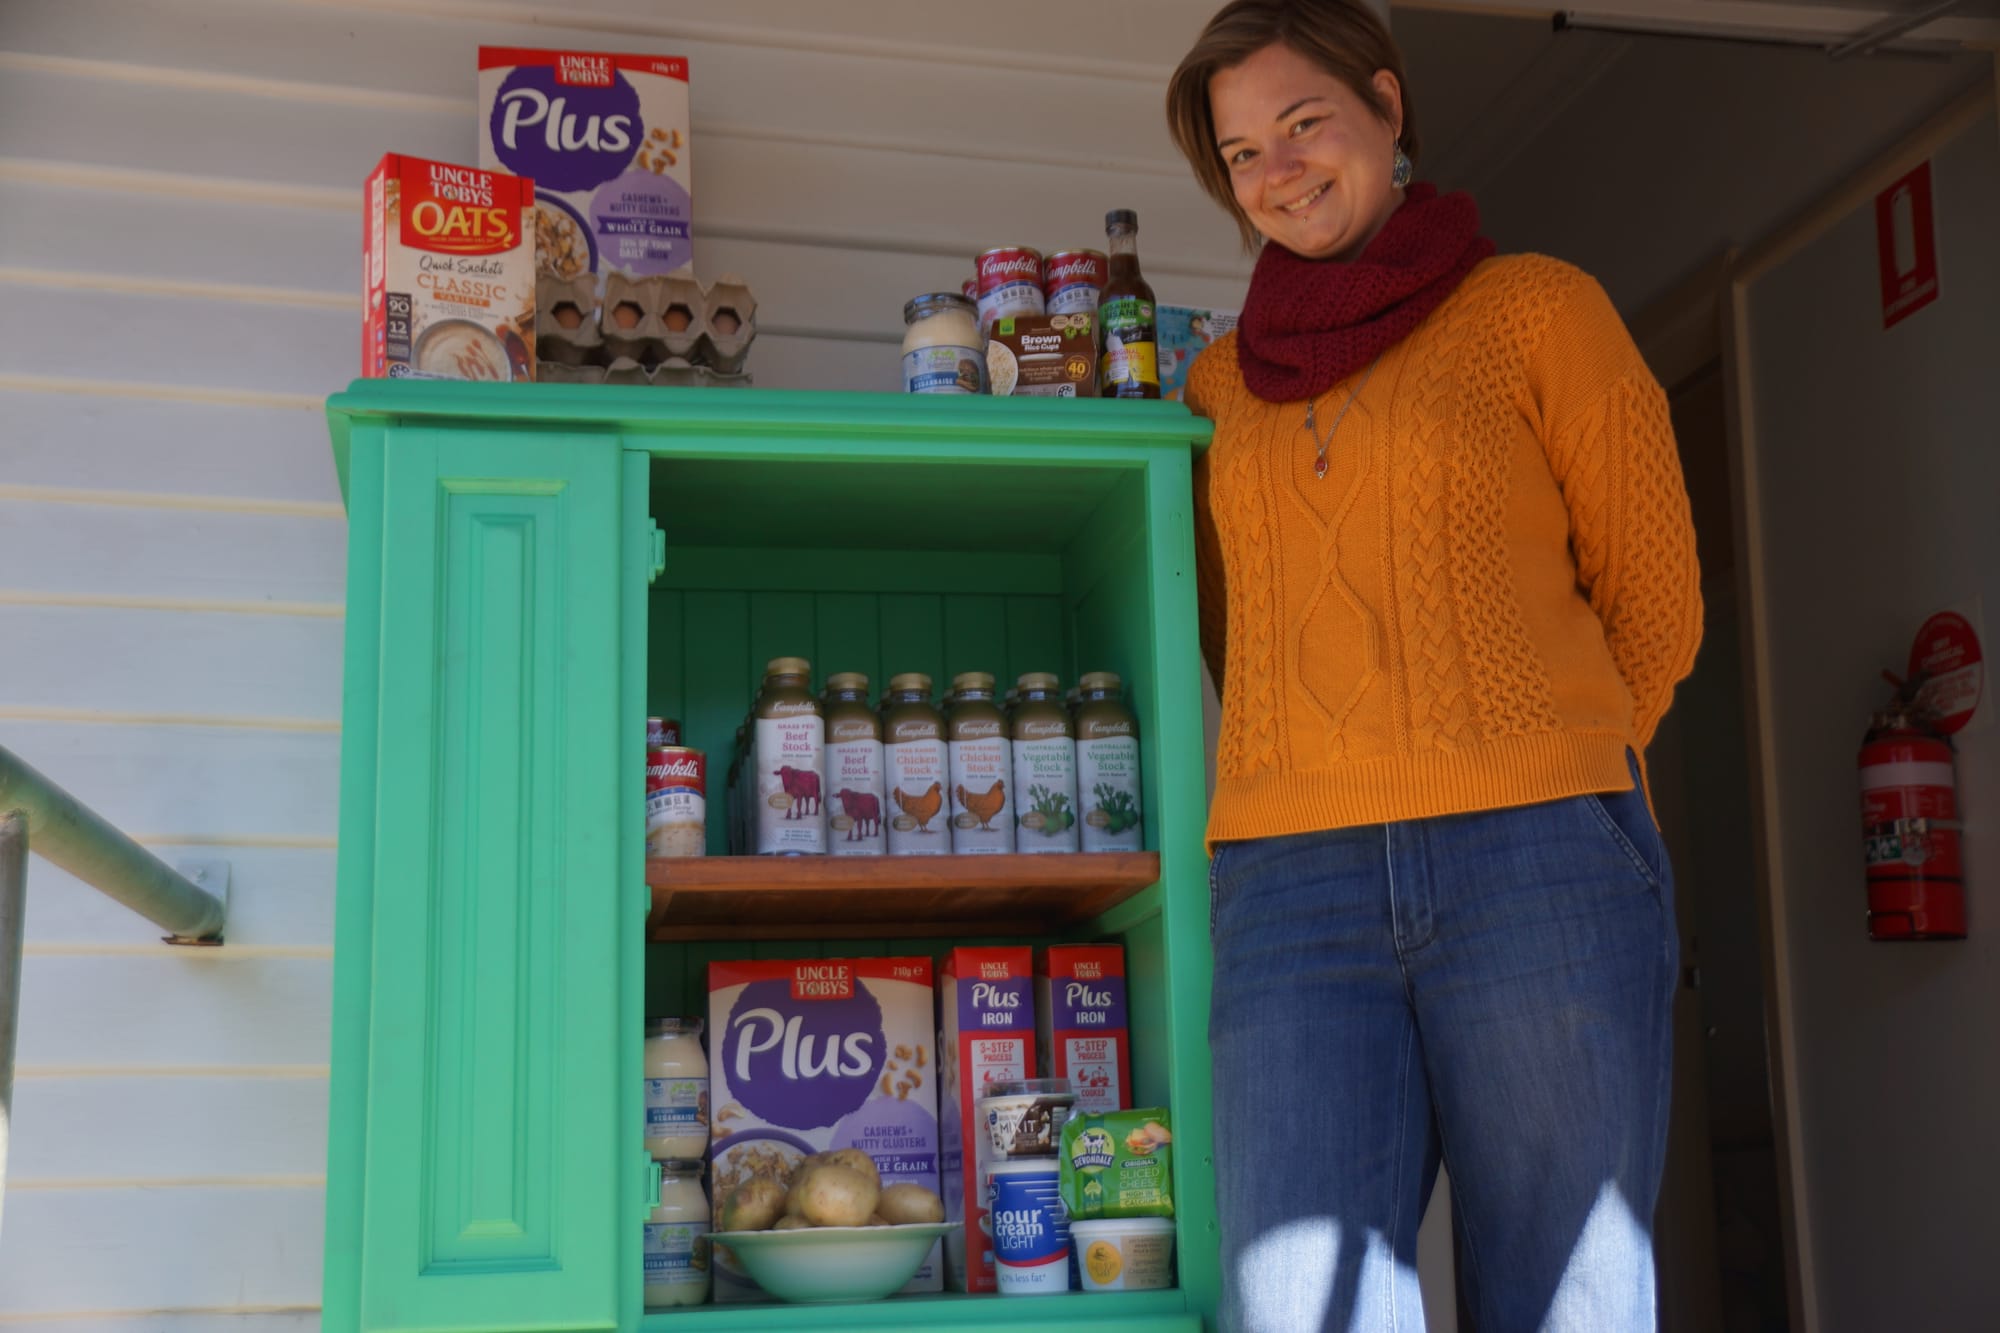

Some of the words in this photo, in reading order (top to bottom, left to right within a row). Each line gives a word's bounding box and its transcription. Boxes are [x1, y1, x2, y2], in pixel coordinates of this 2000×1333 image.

[560, 55, 609, 70] UNCLE
[562, 67, 610, 84] TOBYS
[501, 88, 632, 152] Plus
[430, 164, 493, 190] UNCLE
[430, 181, 493, 207] TOBYS
[412, 201, 509, 237] OATS
[606, 223, 645, 233] WHOLE
[649, 224, 682, 236] GRAIN
[419, 255, 454, 272] Quick
[457, 258, 505, 275] Sachets
[416, 273, 507, 301] CLASSIC
[389, 300, 409, 313] 90
[389, 320, 408, 334] 12
[1021, 335, 1061, 345] Brown
[1040, 343, 1059, 351] Cups
[1068, 362, 1085, 374] 40
[784, 731, 808, 741] Beef
[782, 741, 811, 752] Stock
[844, 755, 867, 765] Beef
[896, 755, 938, 765] Chicken
[959, 752, 1001, 762] Chicken
[1021, 751, 1072, 762] Vegetable
[1086, 750, 1135, 761] Vegetable
[647, 758, 699, 779] ampbell's
[841, 766, 869, 775] Stock
[903, 766, 932, 775] Stock
[966, 763, 996, 773] Stock
[1032, 762, 1062, 772] Stock
[1097, 761, 1125, 771] Stock
[893, 965, 911, 977] 710g
[981, 962, 1008, 970] UNCLE
[1073, 962, 1101, 970] UNCLE
[796, 966, 848, 981] UNCLE
[981, 969, 1009, 978] TOBYS
[796, 980, 849, 996] TOBYS
[972, 982, 1020, 1008] Plus
[1065, 982, 1112, 1007] Plus
[982, 1012, 1013, 1024] IRON
[1076, 1011, 1105, 1024] IRON
[734, 1007, 873, 1081] Plus
[980, 1041, 1014, 1054] 3-STEP
[1074, 1040, 1107, 1052] 3-STEP
[983, 1053, 1013, 1062] PROCESS
[1077, 1051, 1106, 1060] PROCESS
[1081, 1088, 1105, 1097] COOKED
[864, 1125, 907, 1137] CASHEWS
[851, 1138, 879, 1149] NUTTY
[882, 1137, 927, 1149] CLUSTERS
[894, 1160, 928, 1171] GRAIN
[1073, 1153, 1113, 1168] DEVONDALE
[1124, 1158, 1155, 1167] ORIGINAL
[1119, 1167, 1160, 1180] SLICED
[1119, 1178, 1160, 1190] CHEESE
[995, 1208, 1042, 1225] sour
[995, 1222, 1043, 1237] cream
[1001, 1235, 1035, 1249] LIGHT
[1015, 1272, 1030, 1283] less
